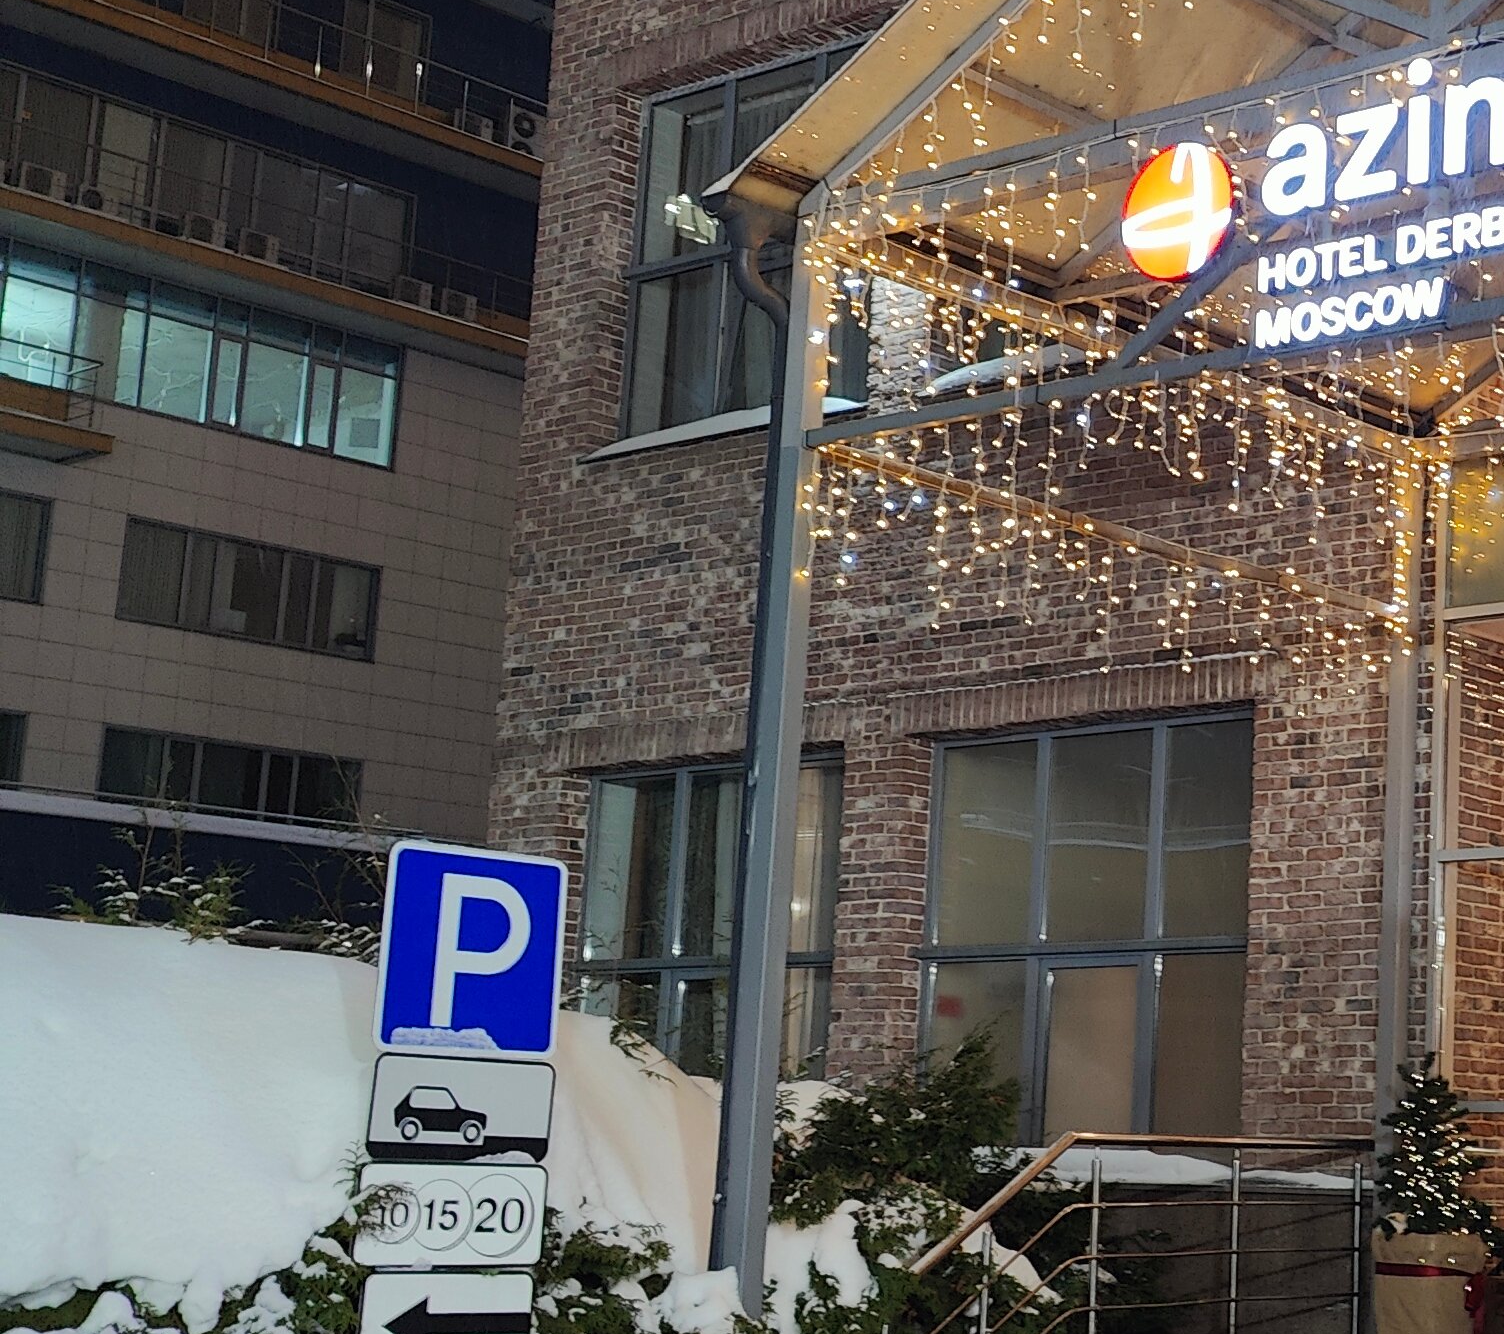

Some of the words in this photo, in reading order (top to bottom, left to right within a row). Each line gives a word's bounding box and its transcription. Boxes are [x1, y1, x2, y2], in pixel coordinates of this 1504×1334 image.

[1257, 233, 1389, 294] HOTEL
[1254, 277, 1444, 349] MOSCOW
[429, 872, 531, 1028] P
[377, 1201, 409, 1228] 10
[424, 1198, 460, 1231] 15
[474, 1197, 525, 1234] 20
